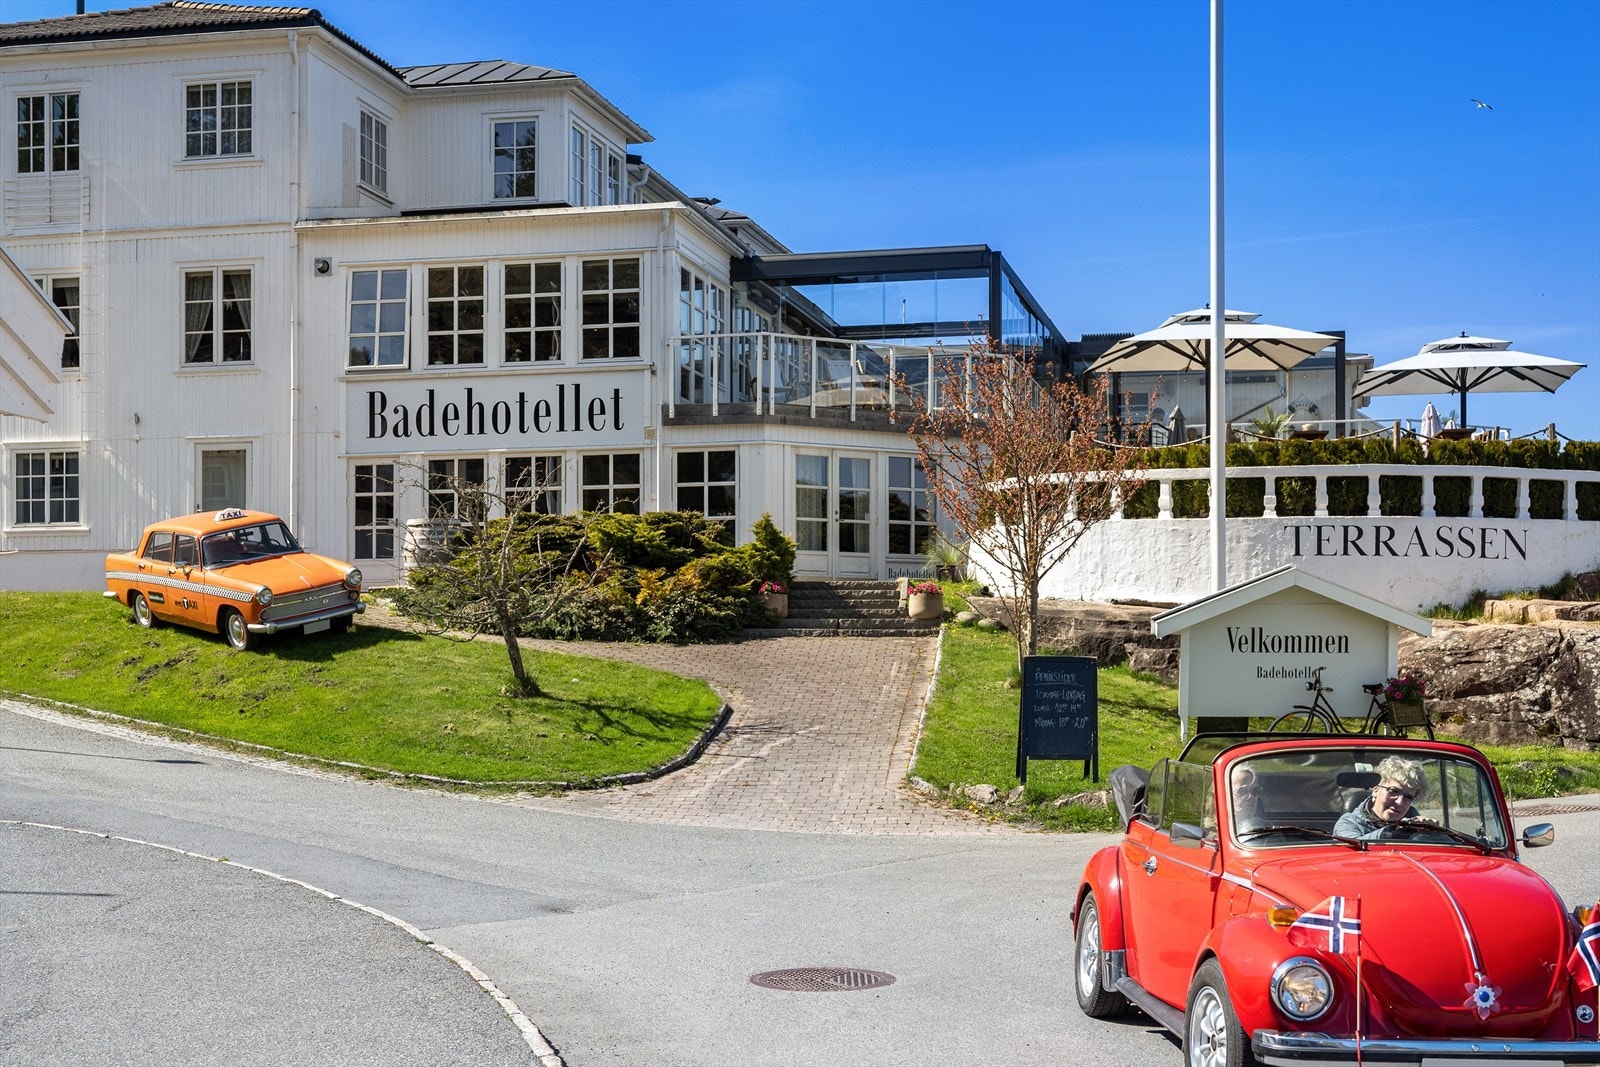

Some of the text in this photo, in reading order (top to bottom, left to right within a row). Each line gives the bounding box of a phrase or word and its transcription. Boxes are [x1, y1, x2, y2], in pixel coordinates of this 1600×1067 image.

[366, 383, 625, 439] Badehotellet
[220, 510, 241, 519] TAXI
[1283, 524, 1530, 561] TERRASSEN
[1226, 626, 1349, 654] Velkommen
[1256, 666, 1318, 679] Badehotelle
